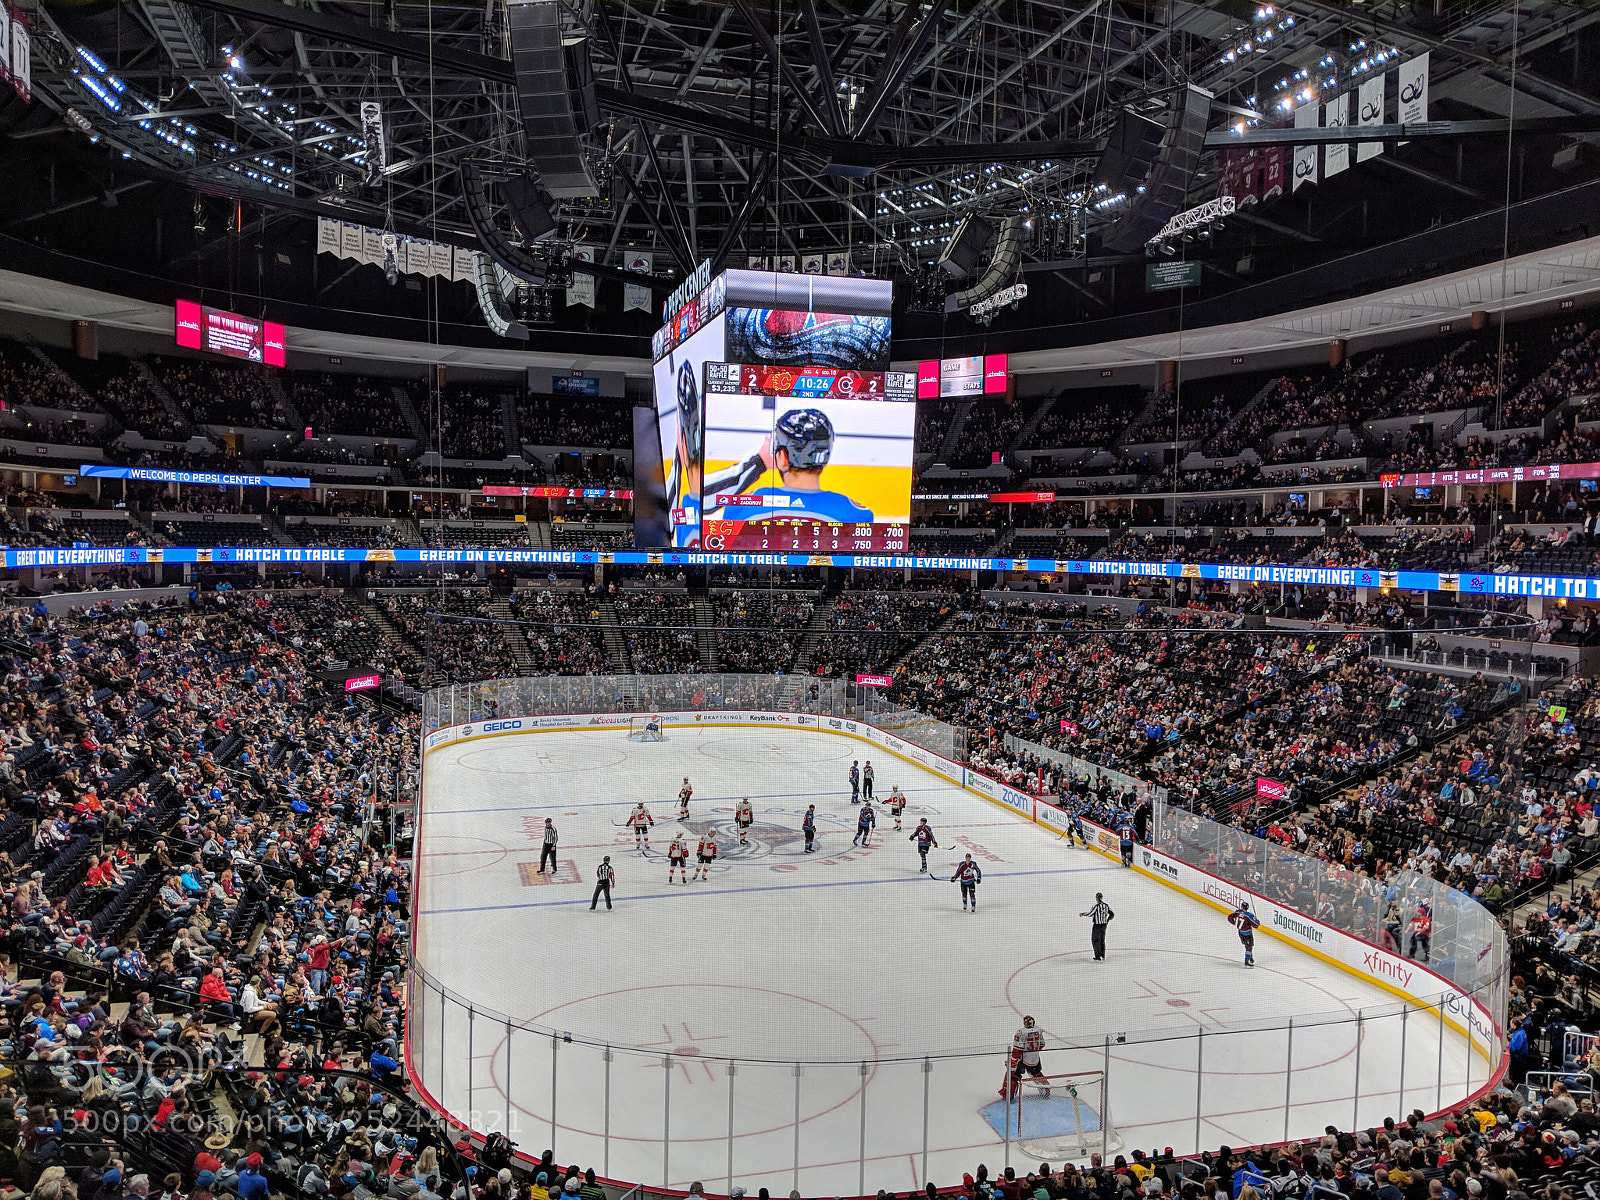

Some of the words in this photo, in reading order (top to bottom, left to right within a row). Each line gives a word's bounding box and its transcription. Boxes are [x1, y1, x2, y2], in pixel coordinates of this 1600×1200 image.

[1268, 163, 1279, 181] 22
[668, 282, 685, 320] PEPSI
[685, 258, 711, 303] CENTER
[221, 317, 234, 327] YOU
[943, 363, 960, 372] GAME
[709, 371, 728, 379] RAFFLE
[748, 374, 757, 387] 2
[711, 385, 736, 393] $3,235
[801, 378, 829, 389] 10:26
[869, 380, 877, 393] 2
[886, 380, 904, 388] RAFFLE
[963, 382, 980, 390] STATS
[814, 449, 825, 464] 16
[131, 469, 176, 480] WELCOME
[178, 472, 190, 481] TO
[192, 473, 220, 483] PEPSI
[223, 475, 261, 485] CENTER
[569, 489, 575, 497] 2
[609, 490, 615, 498] 2
[763, 527, 768, 535] 1
[793, 527, 799, 535] 1
[813, 527, 820, 536] 5
[832, 527, 839, 536] 0
[851, 528, 872, 537] .800
[883, 528, 904, 537] .700
[762, 540, 768, 548] 2
[793, 540, 799, 549] 2
[813, 540, 819, 549] 3
[832, 540, 838, 549] 3
[851, 540, 871, 550] .750
[883, 541, 903, 550] .300
[17, 551, 36, 565] GREAT
[38, 551, 54, 564] ON
[57, 549, 125, 564] EVERYTHING!
[235, 550, 280, 561] HATCH
[284, 550, 300, 561] TO
[305, 550, 345, 561] TABLE
[419, 550, 463, 561] GREAT
[466, 550, 484, 561] ON
[487, 551, 576, 562] EVERYTHING!
[688, 554, 728, 564] HATCH
[731, 555, 746, 564] TO
[749, 555, 788, 565] TABLE
[853, 556, 893, 567] GREAT
[896, 557, 913, 568] ON
[916, 558, 992, 569] EVERYTHING!
[1089, 561, 1126, 574] HATCH
[1128, 562, 1138, 574] TO
[1140, 562, 1167, 576] TABLE
[1217, 566, 1252, 580] GREAT
[1254, 567, 1269, 581] ON
[1273, 567, 1355, 585] EVERYTHING!
[1494, 575, 1556, 596] HATCH
[1562, 579, 1586, 598] TO
[349, 677, 375, 689] uchealth
[859, 676, 888, 686] uchealth
[596, 716, 617, 724] Coors
[750, 714, 776, 722] KeyBank
[483, 720, 522, 732] GEICO
[968, 772, 993, 794] enterprise
[1002, 789, 1029, 812] zoom
[1122, 830, 1130, 840] 13
[1153, 858, 1178, 876] RAM
[1203, 881, 1244, 908] uchealth
[1235, 917, 1244, 930] 17
[1273, 909, 1323, 944] Jägermeister
[1363, 951, 1413, 988] xfinity
